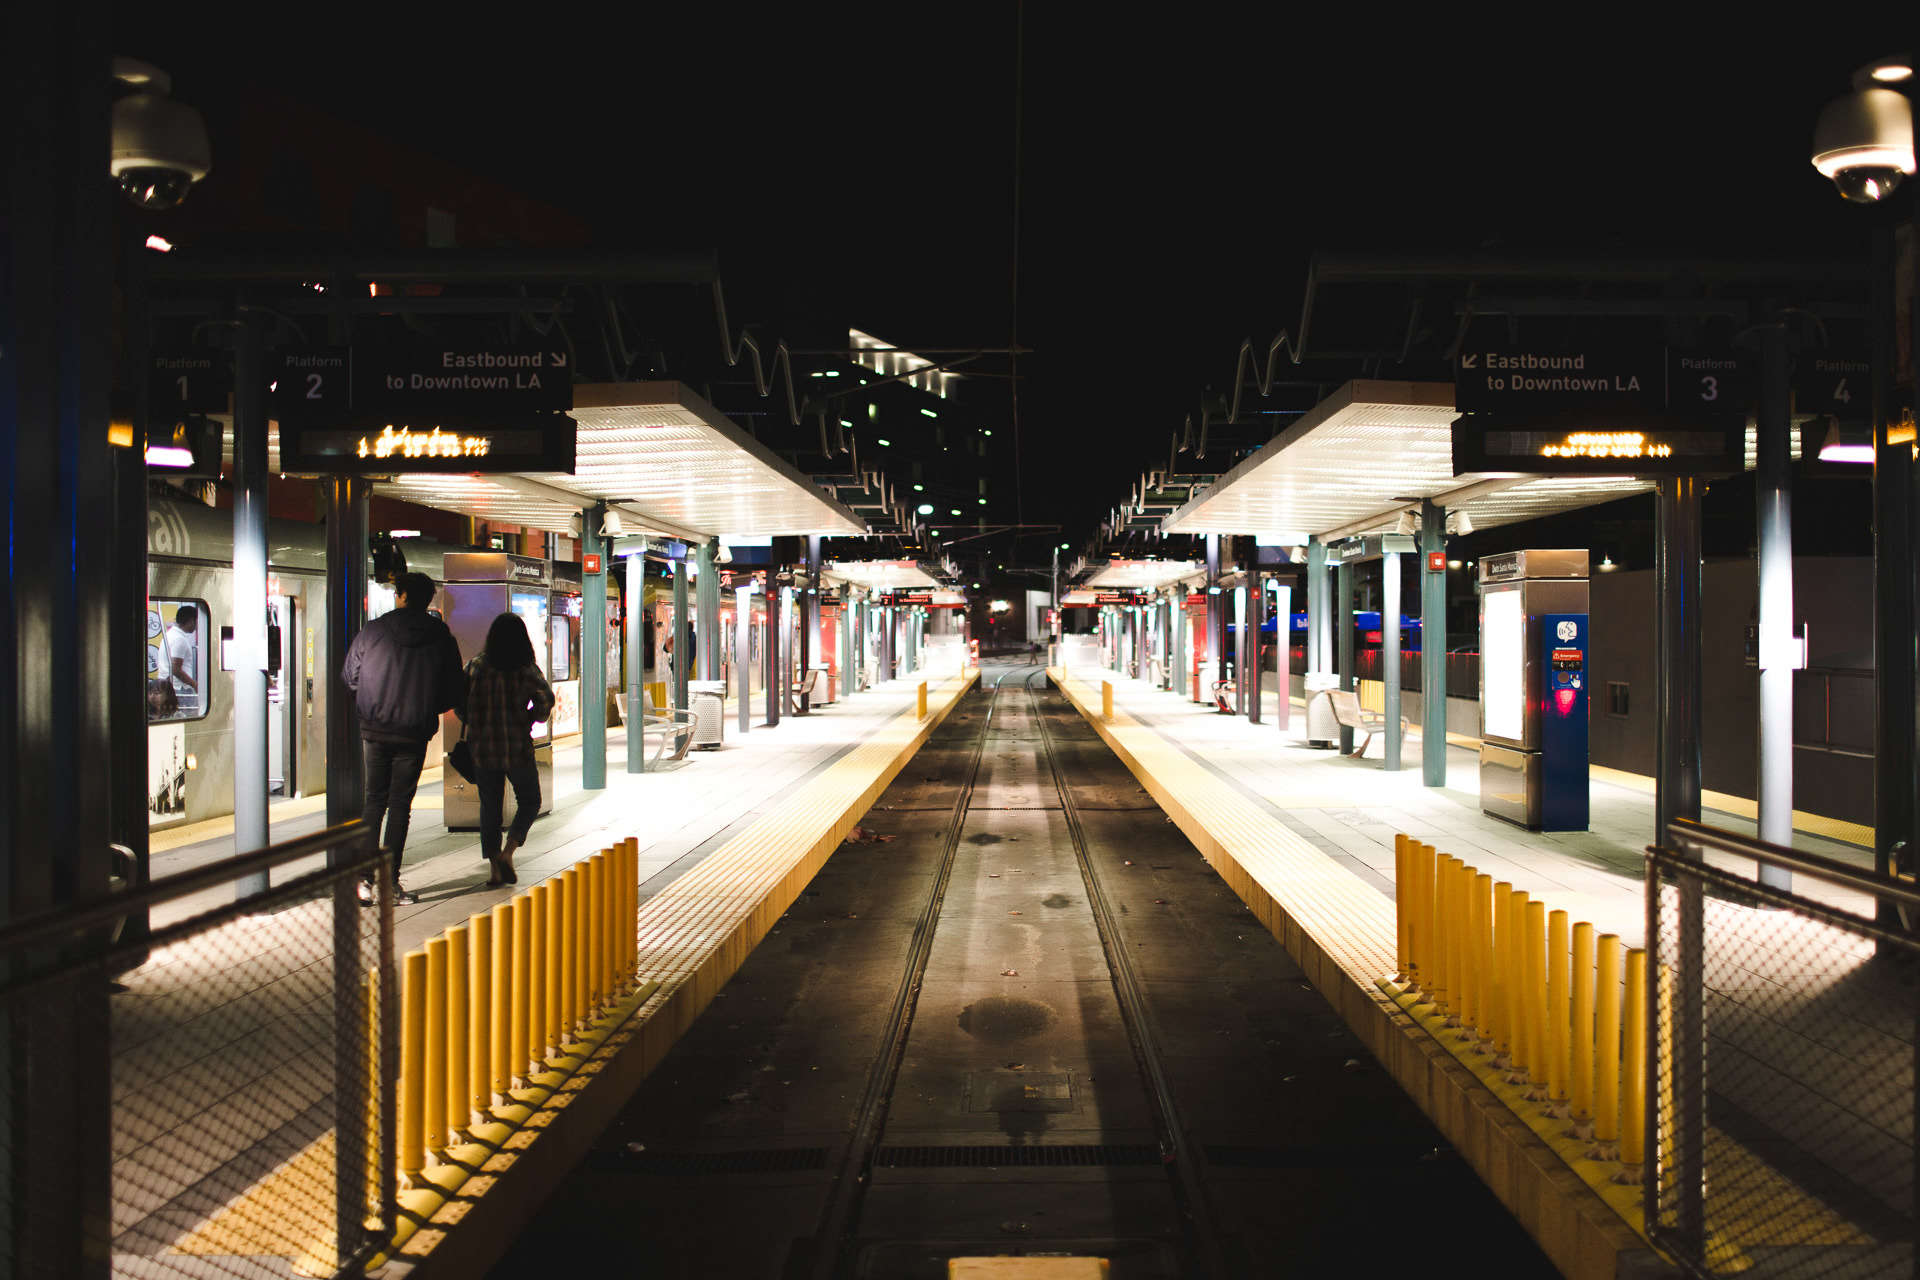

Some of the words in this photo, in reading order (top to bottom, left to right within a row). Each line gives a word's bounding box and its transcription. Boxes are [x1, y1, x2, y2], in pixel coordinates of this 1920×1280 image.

[156, 357, 211, 370] Platform
[286, 355, 342, 368] Platform
[443, 351, 542, 369] Eastbound
[1486, 353, 1584, 370] Eastbound
[1682, 357, 1736, 371] Platform
[1816, 359, 1869, 373] Platform
[176, 375, 188, 400] 1
[306, 374, 323, 399] 2
[386, 374, 404, 389] to
[411, 373, 509, 390] Downtown
[516, 373, 541, 389] LA
[1487, 376, 1504, 391] to
[1511, 375, 1608, 392] Downtown
[1615, 376, 1640, 391] LA
[1701, 376, 1718, 400] 3
[1833, 378, 1851, 403] 4
